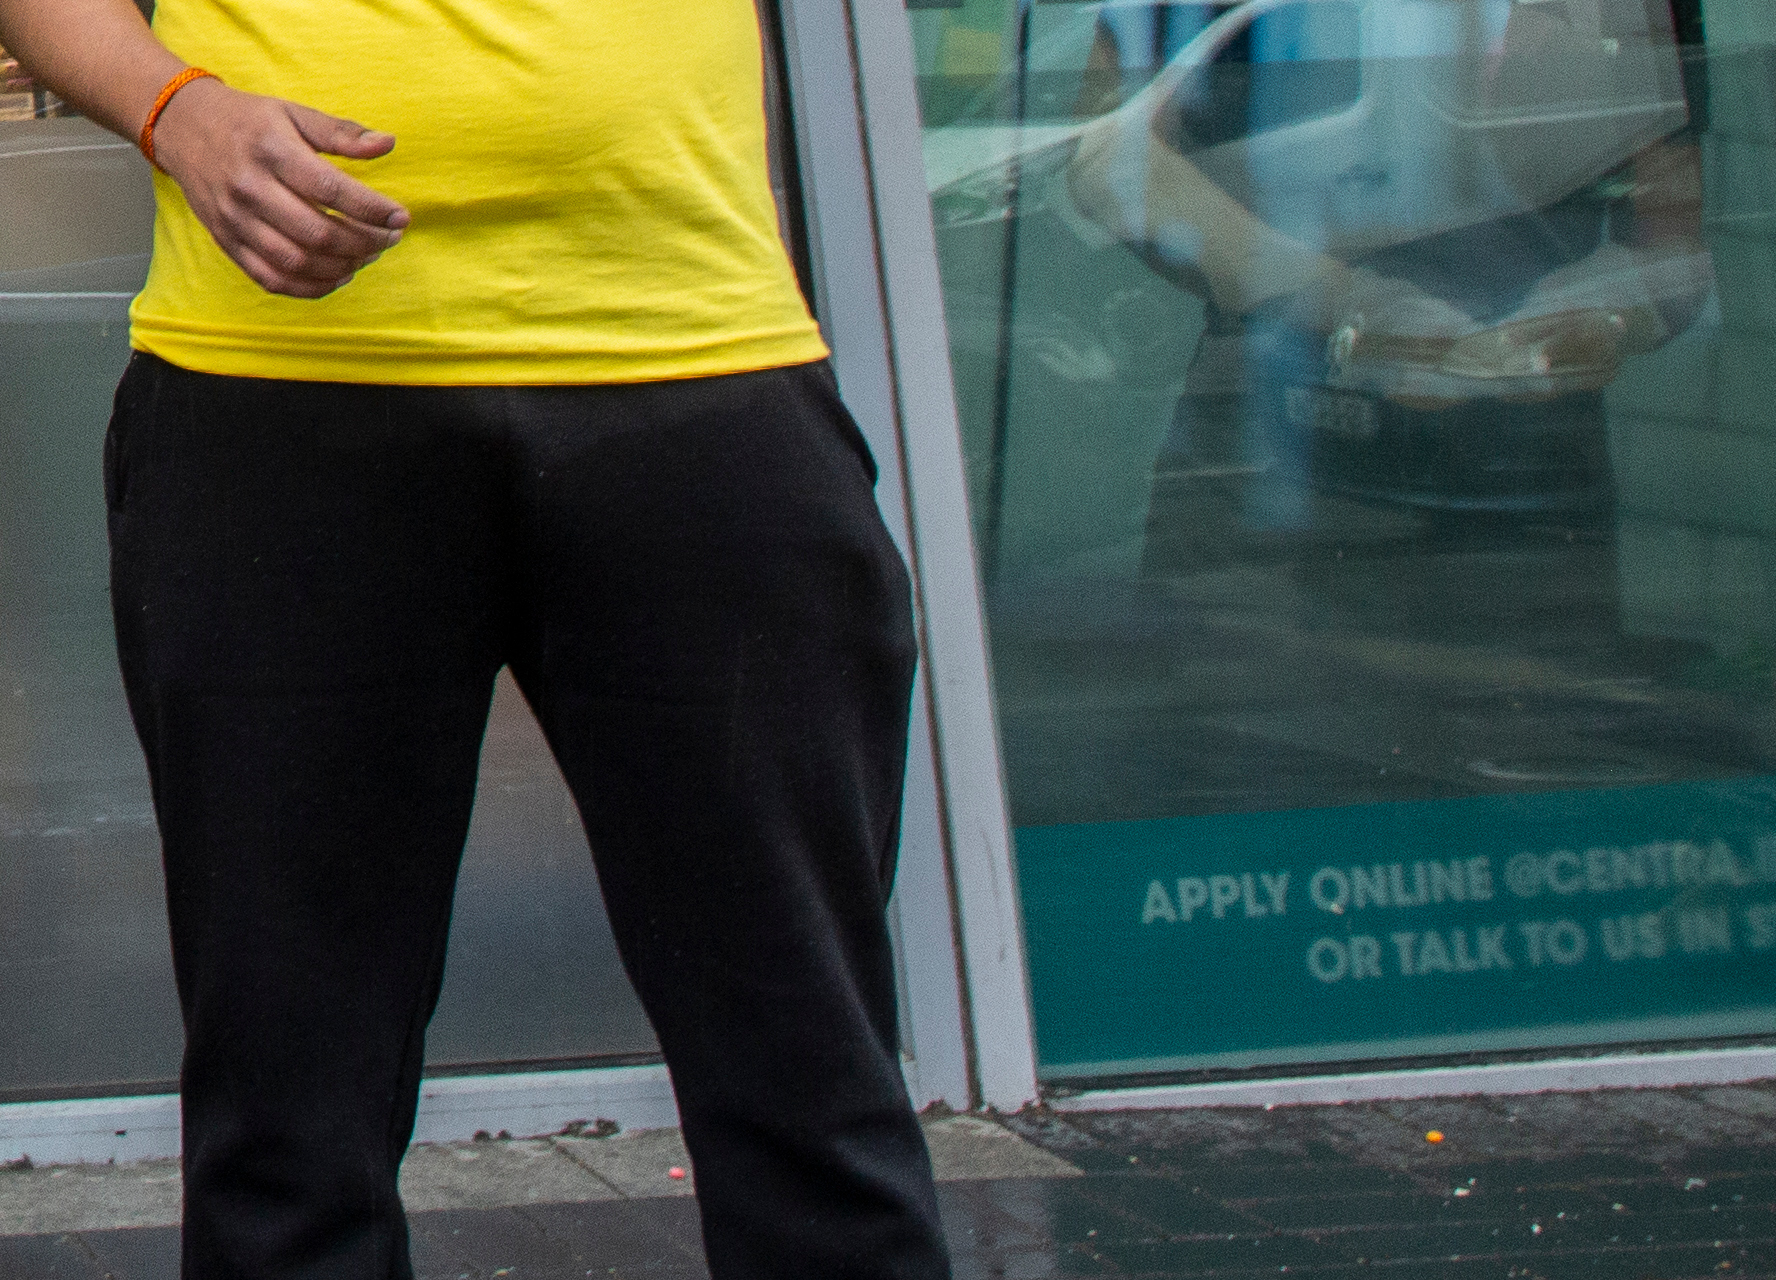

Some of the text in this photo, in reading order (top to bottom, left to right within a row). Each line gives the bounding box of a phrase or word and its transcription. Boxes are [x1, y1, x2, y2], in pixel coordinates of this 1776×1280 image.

[1142, 871, 1291, 925] APPLY
[1309, 853, 1494, 911] ONLINE
[1307, 936, 1384, 983] OR
[1390, 926, 1516, 977] TALK
[1522, 920, 1589, 967] TO
[1602, 910, 1666, 960] US
[1678, 906, 1731, 954] IN
